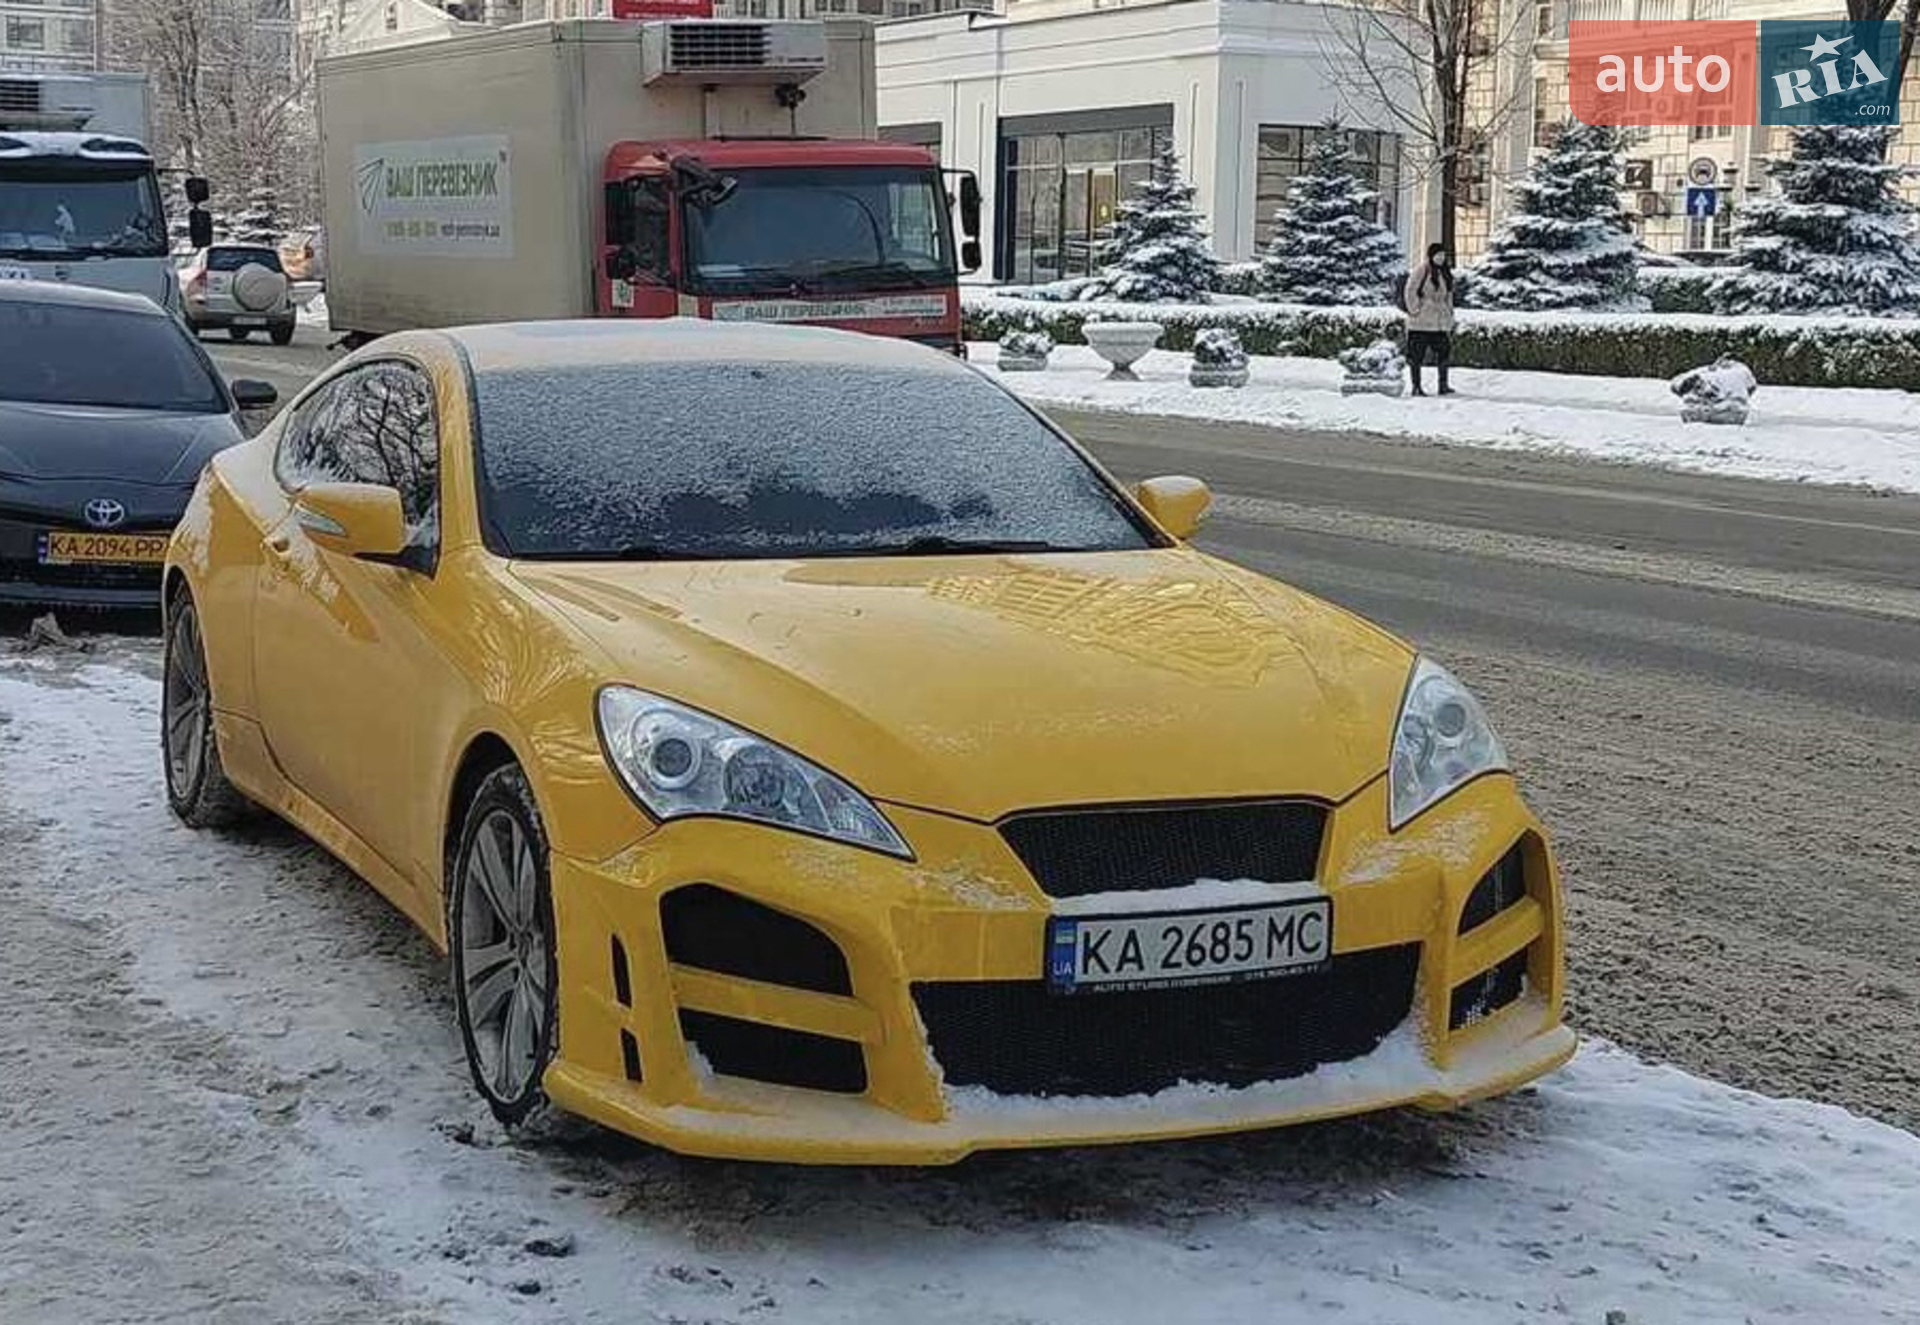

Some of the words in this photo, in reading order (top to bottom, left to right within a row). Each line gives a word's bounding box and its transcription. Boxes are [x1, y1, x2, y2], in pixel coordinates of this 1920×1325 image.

[386, 166, 414, 197] ВАШ
[84, 538, 131, 557] 2094
[1082, 928, 1145, 975] KA
[1160, 918, 1254, 969] 2685
[1266, 910, 1322, 961] MC
